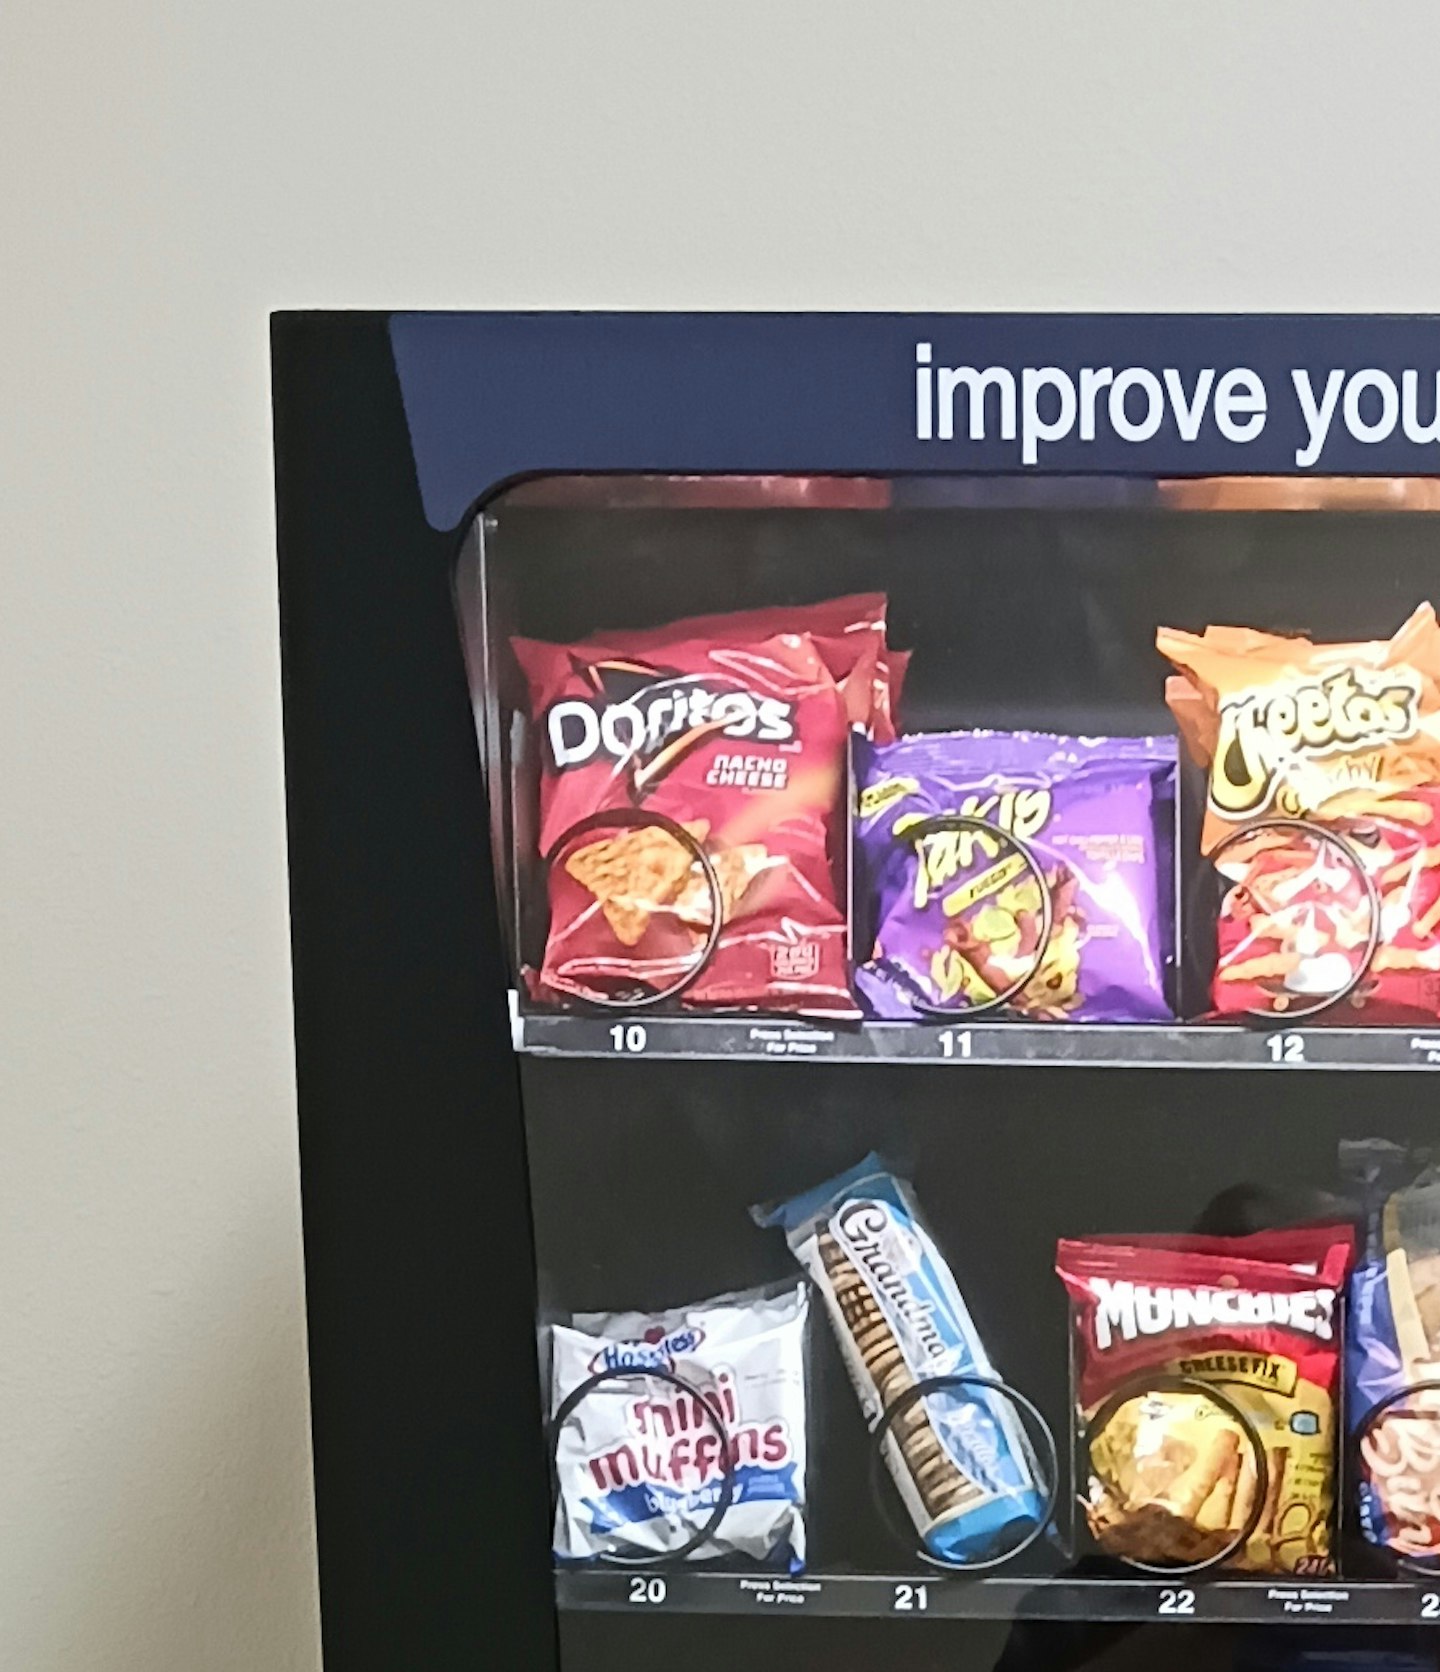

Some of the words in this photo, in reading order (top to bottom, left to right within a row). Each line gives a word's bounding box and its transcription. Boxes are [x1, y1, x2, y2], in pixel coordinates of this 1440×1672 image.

[916, 341, 1267, 465] improve
[547, 688, 794, 768] Doritos
[1211, 668, 1415, 812] Cheetos
[713, 755, 788, 771] NACHO
[706, 770, 788, 789] CHEESE
[609, 1026, 647, 1052] 10
[938, 1031, 974, 1057] 11
[1267, 1035, 1305, 1062] 12
[1089, 1277, 1338, 1349] MUNCHIES
[634, 1372, 736, 1437] mini
[629, 1577, 667, 1603] 20
[894, 1585, 928, 1610] 21
[1159, 1589, 1196, 1614] 22
